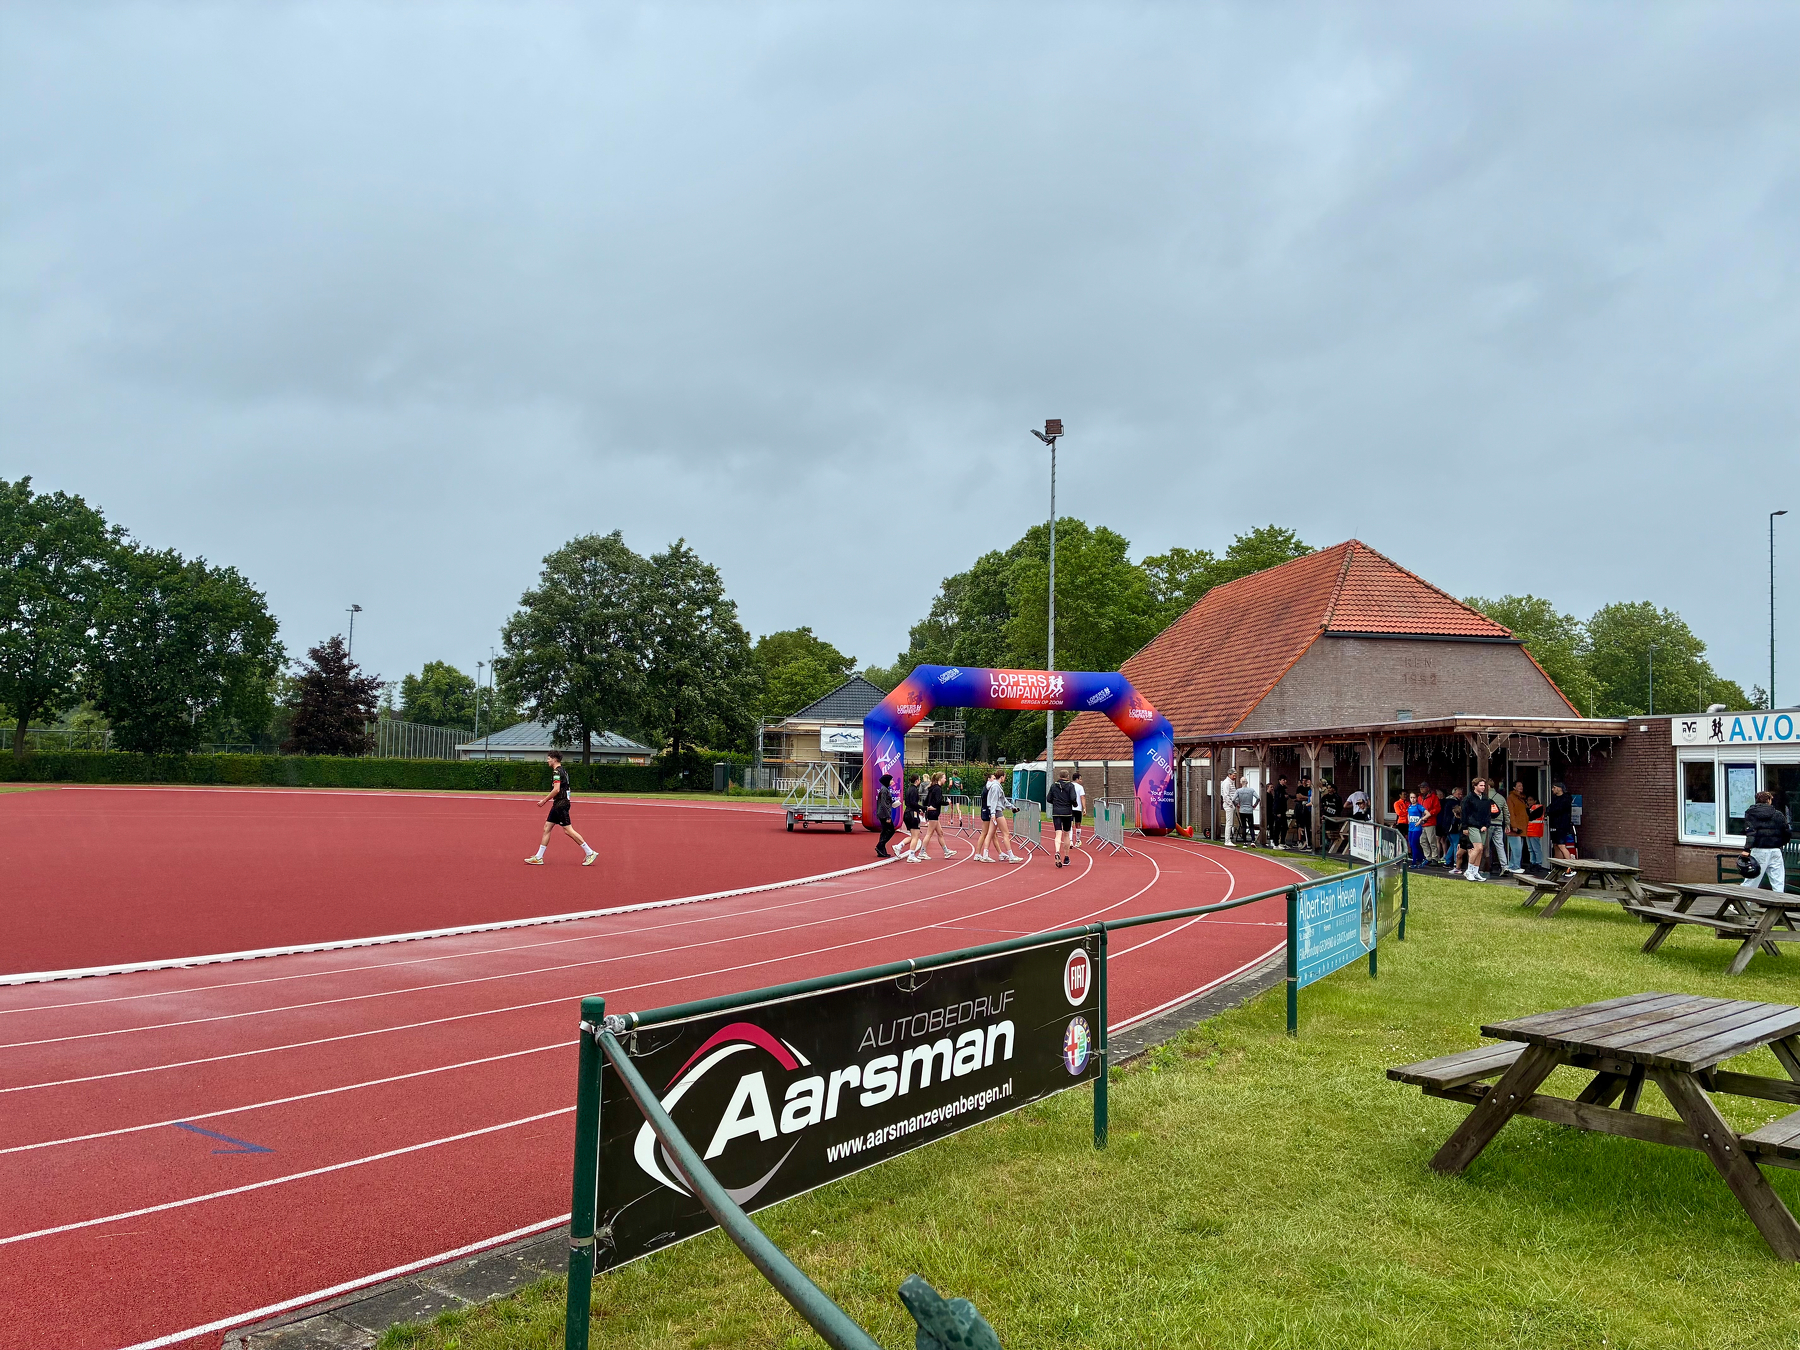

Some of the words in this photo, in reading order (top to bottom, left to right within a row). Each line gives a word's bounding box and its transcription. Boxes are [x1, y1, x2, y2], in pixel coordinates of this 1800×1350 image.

[990, 673, 1047, 687] LOPERS
[990, 685, 1047, 699] COMPANY
[1146, 748, 1174, 780] FUSION
[1299, 893, 1320, 922] Albert
[1320, 888, 1336, 919] Heijn
[1337, 886, 1357, 909] Hoeven
[1070, 964, 1086, 991] FIAT
[857, 990, 1015, 1053] AUTOBEDRIJF
[703, 1020, 1015, 1161] Aarsman
[826, 1077, 1013, 1164] www.aarsmanzevenbergen.nl
